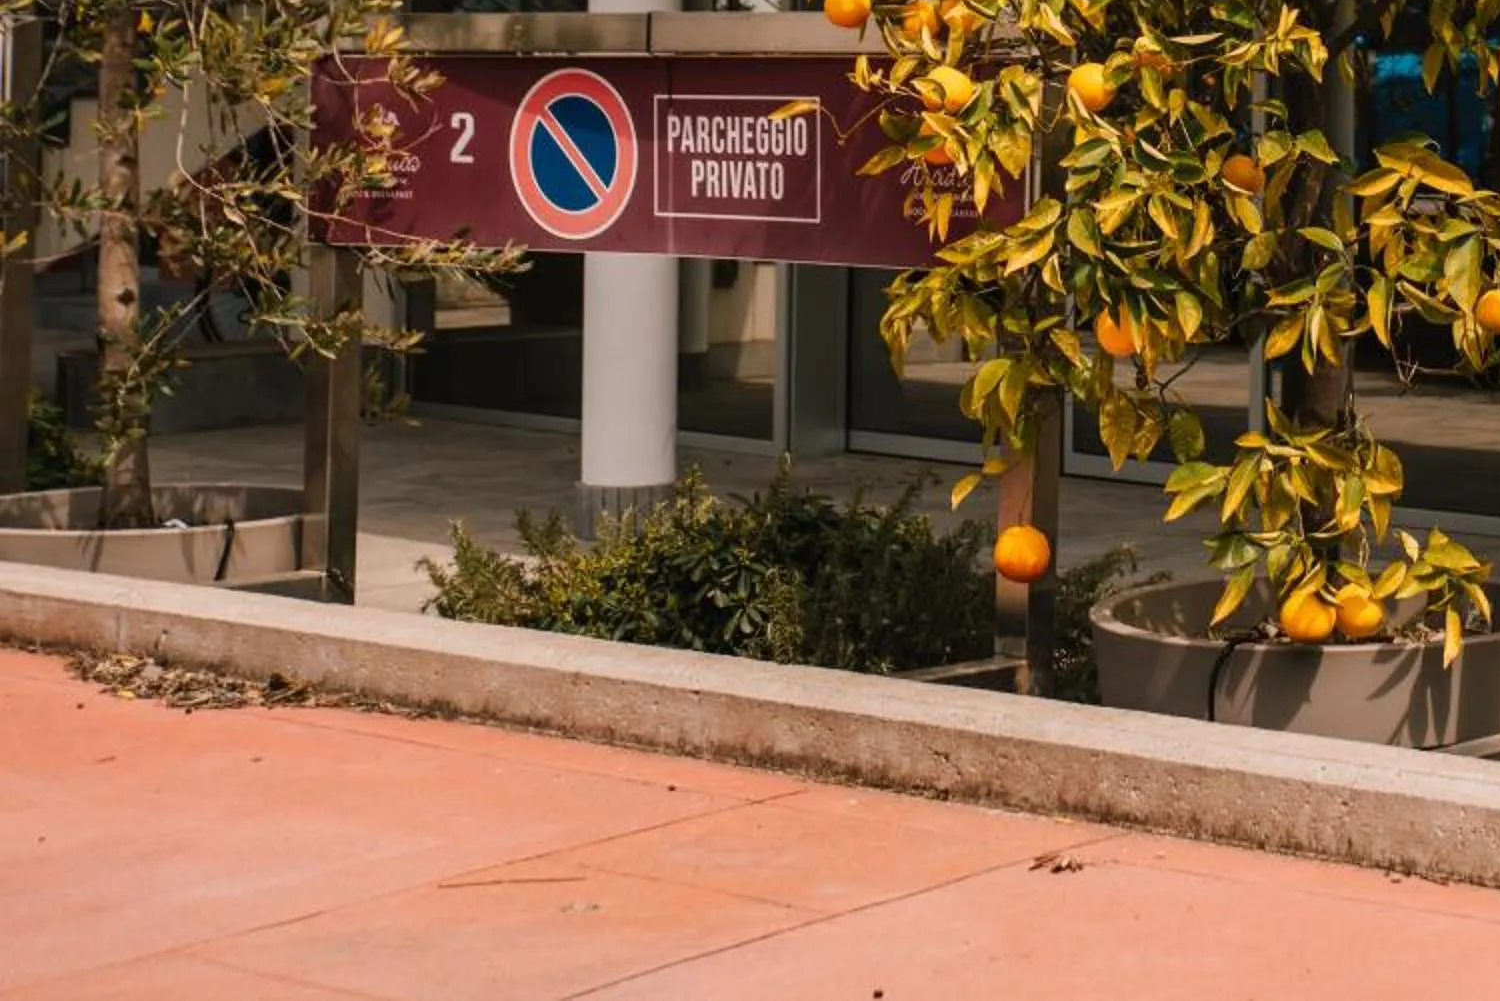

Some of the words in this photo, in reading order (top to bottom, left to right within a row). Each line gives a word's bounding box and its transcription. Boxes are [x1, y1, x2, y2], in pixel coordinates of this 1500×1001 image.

[450, 112, 475, 163] 2
[667, 114, 807, 156] PARCHEGGIO
[691, 159, 784, 200] PRIVATO
